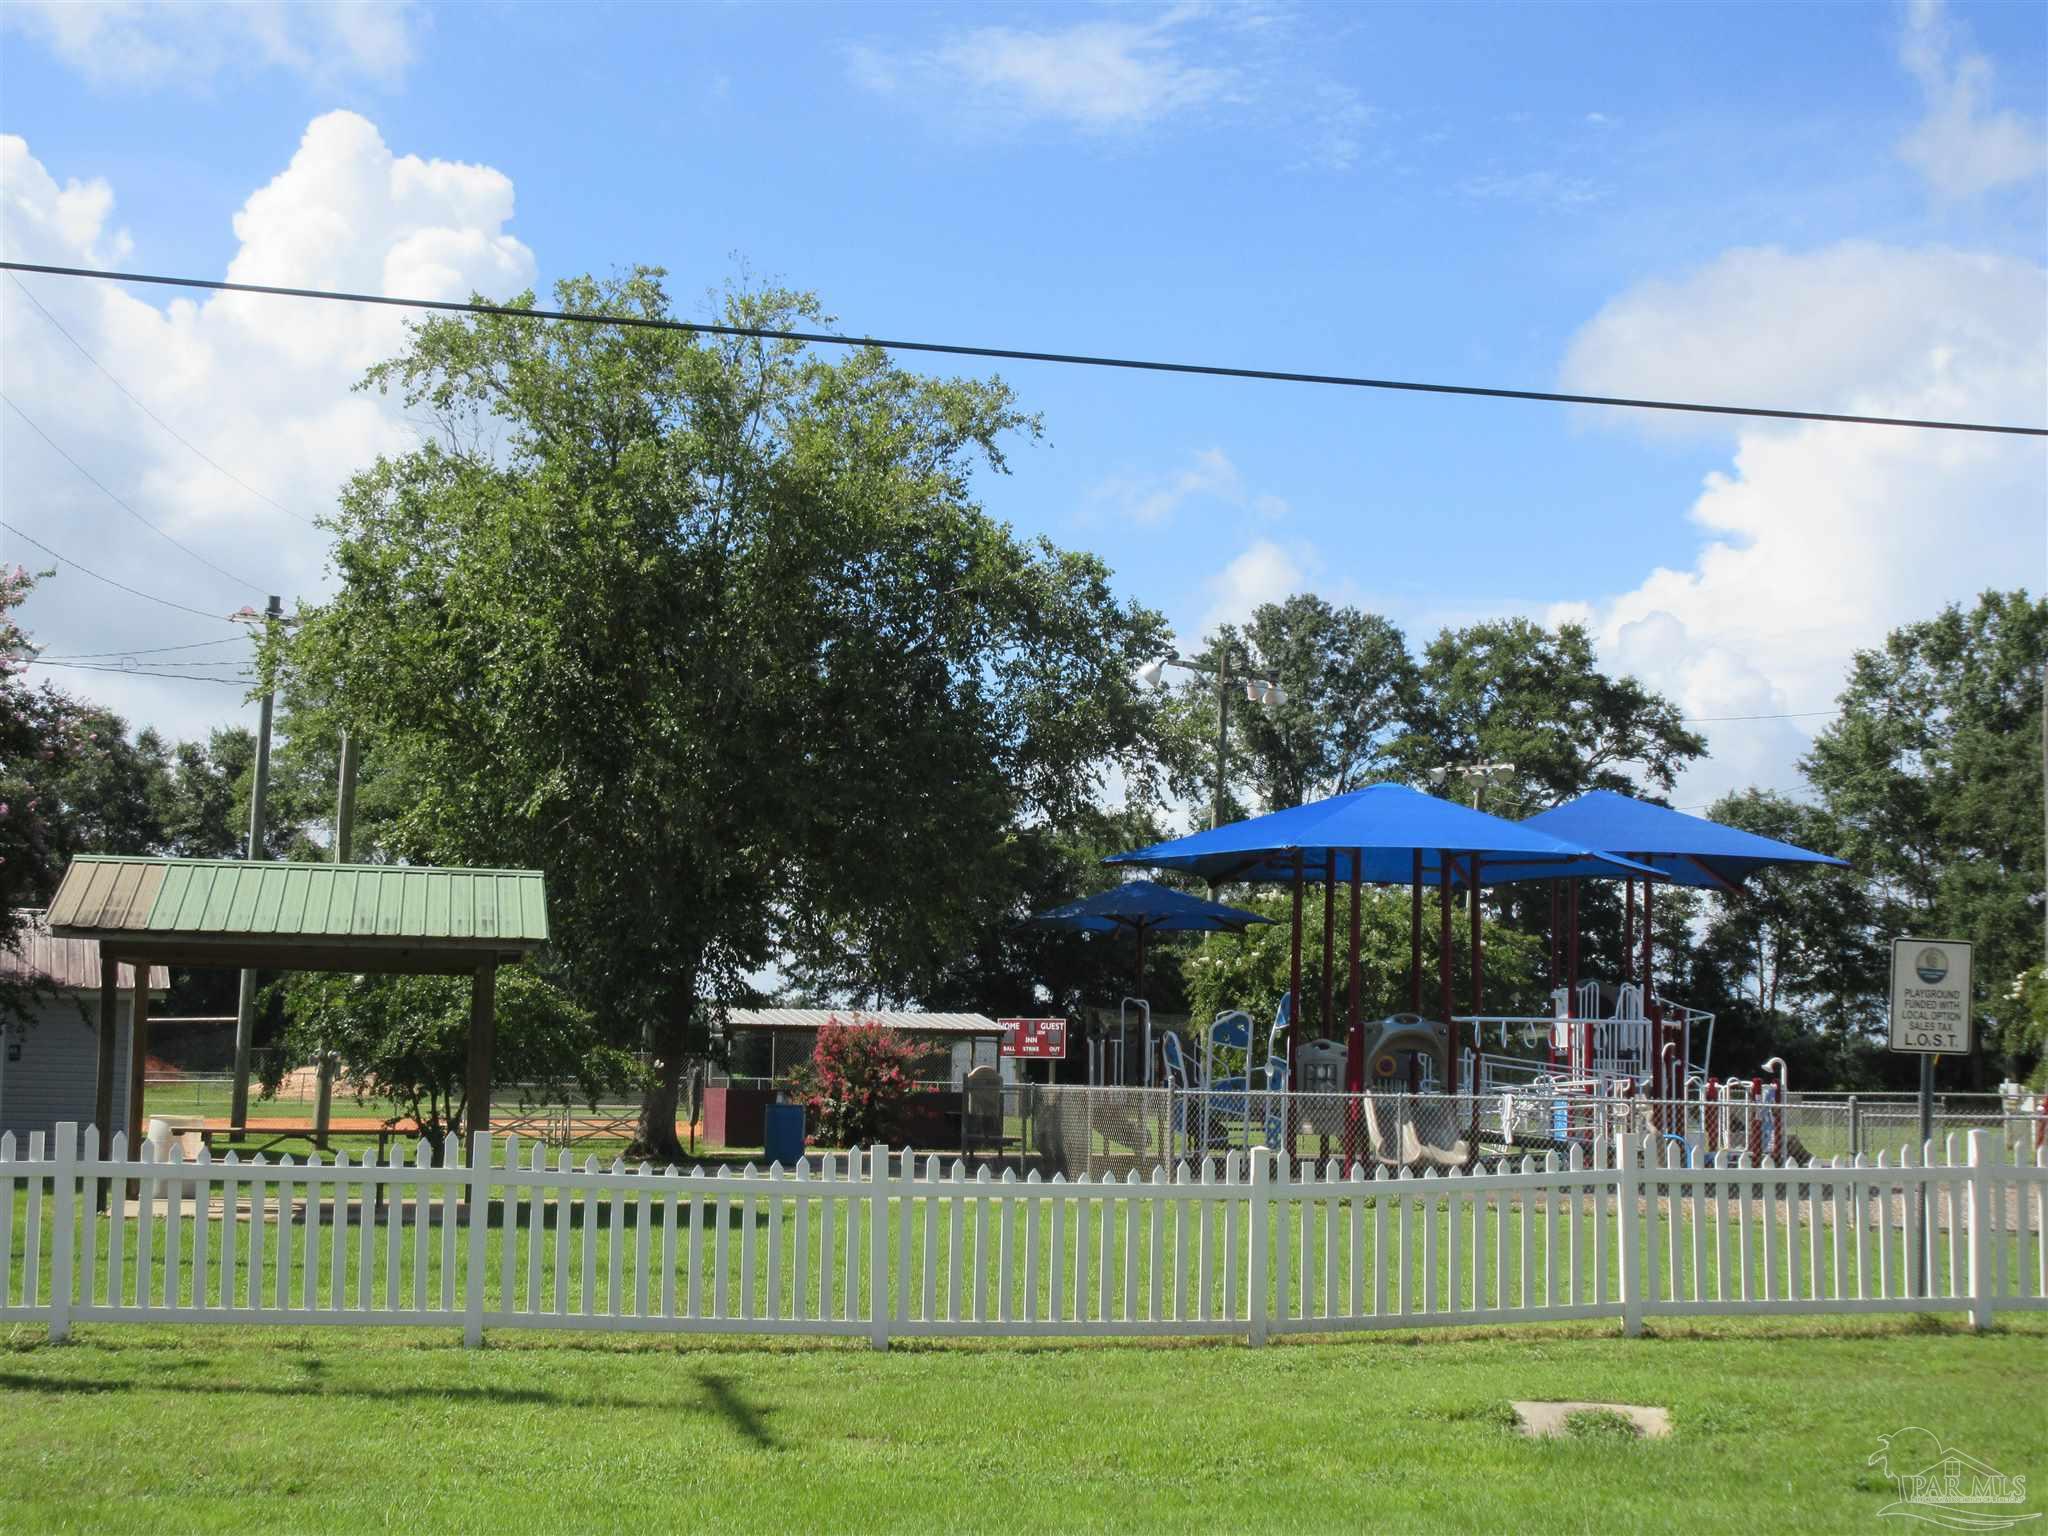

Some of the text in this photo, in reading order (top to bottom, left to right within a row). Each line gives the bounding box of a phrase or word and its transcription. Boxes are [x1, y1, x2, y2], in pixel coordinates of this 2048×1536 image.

[1904, 988, 1960, 999] PLAYGROUND
[1904, 1000, 1960, 1010] FUNDED WITH
[1902, 1010, 1961, 1021] LOCAL OPTION
[1041, 1022, 1064, 1030] GUEST
[1910, 1021, 1953, 1032] SALES TAX
[1905, 1033, 1959, 1048] L.O.S.T.
